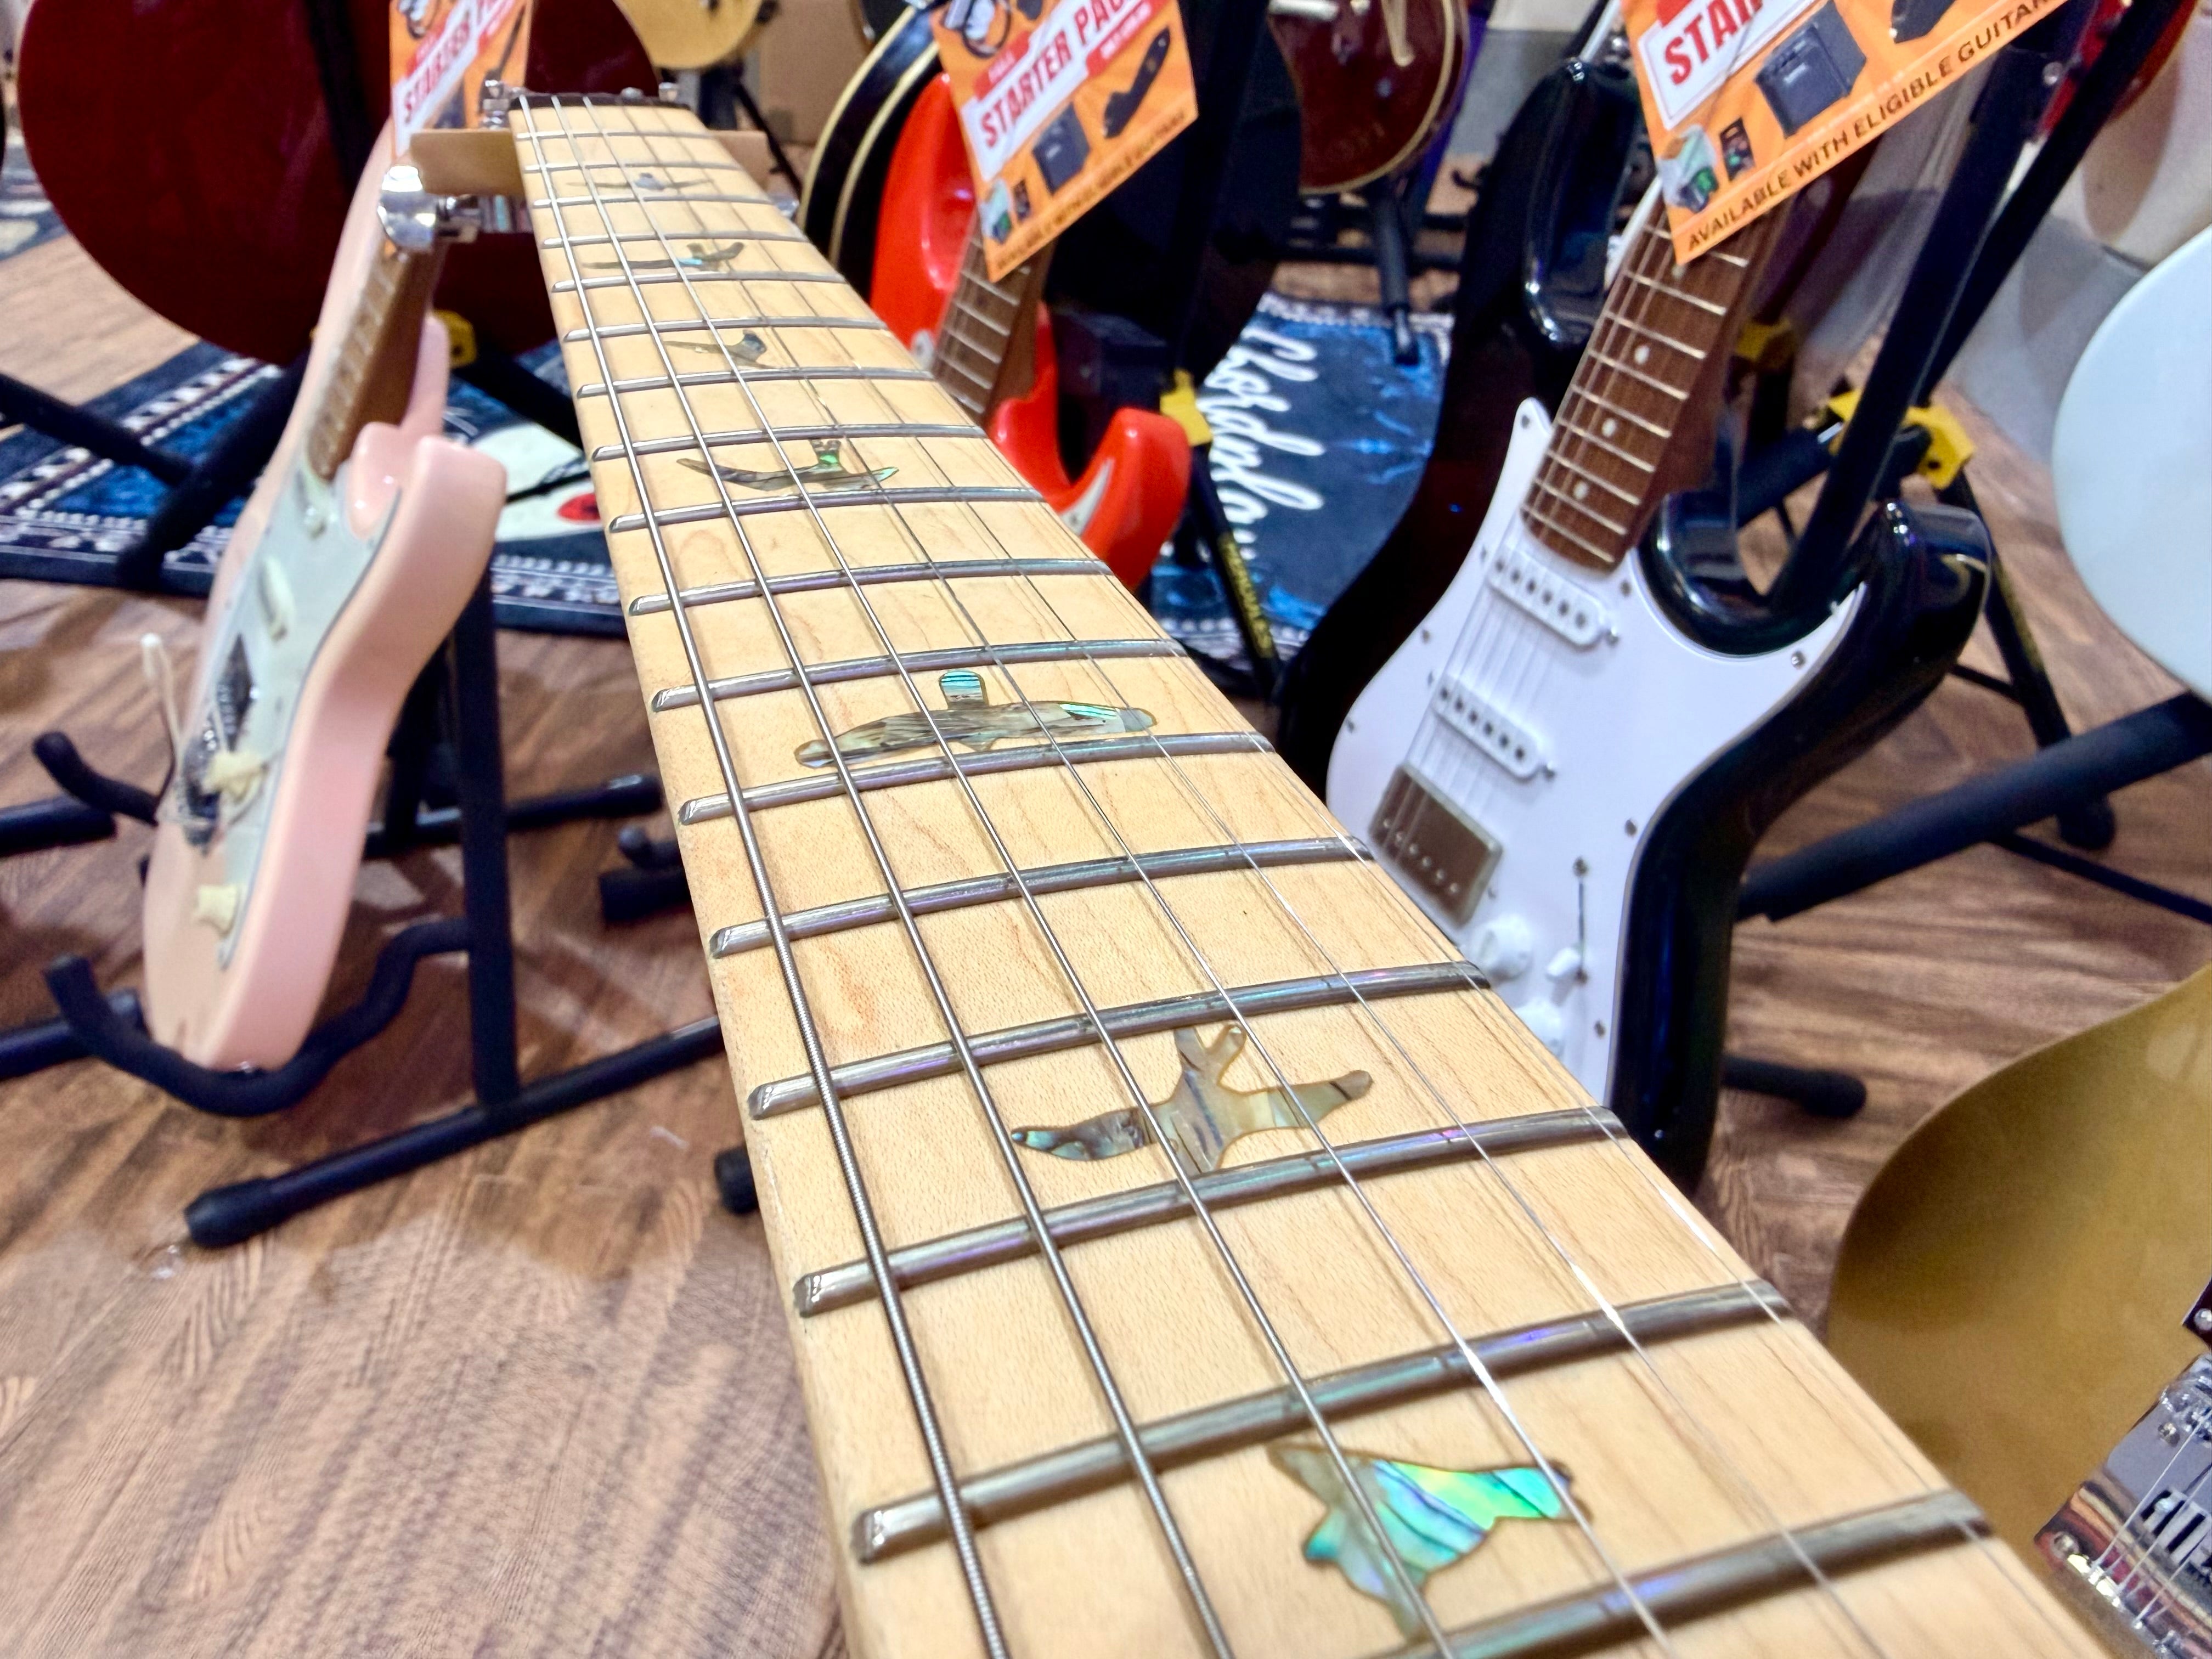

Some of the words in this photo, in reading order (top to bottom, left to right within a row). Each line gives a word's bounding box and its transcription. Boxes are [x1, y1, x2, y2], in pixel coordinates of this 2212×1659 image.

[981, 29, 1072, 148] STARTER
[1688, 169, 1791, 251] AVAILABLE
[1793, 129, 1849, 178] WITH
[1854, 55, 1953, 138] ELIGIBLE
